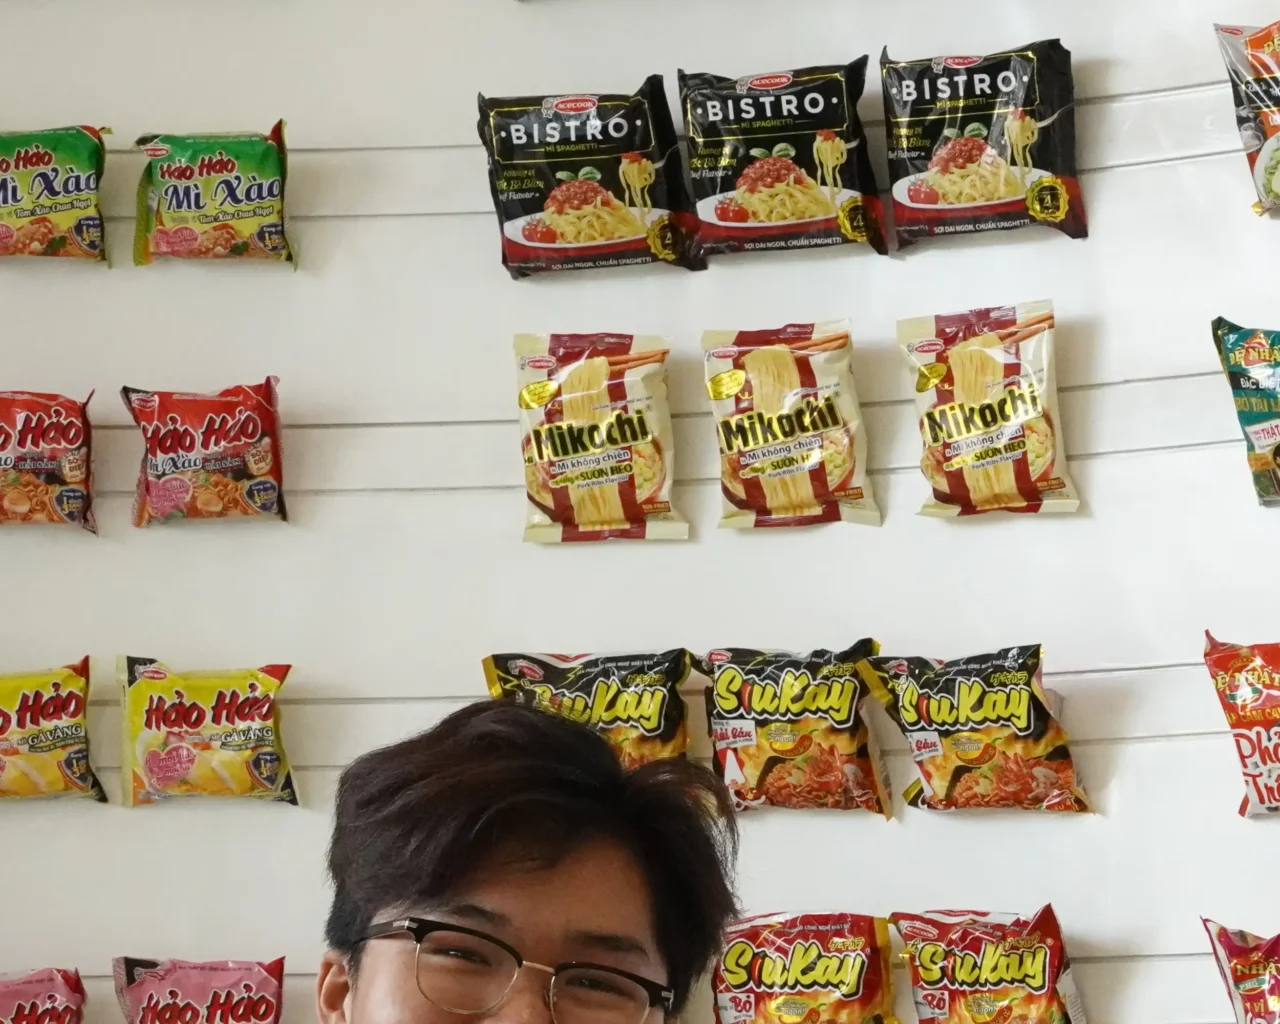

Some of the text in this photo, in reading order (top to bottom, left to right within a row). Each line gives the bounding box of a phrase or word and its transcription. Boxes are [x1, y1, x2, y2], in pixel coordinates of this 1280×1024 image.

[902, 71, 1016, 102] BISTRO
[706, 92, 824, 122] BISTRO
[510, 117, 628, 144] BISTRO
[752, 119, 794, 128] SPAGHETTI
[556, 143, 598, 151] SPAGHETTI
[163, 182, 206, 213] Mì
[720, 395, 841, 453] Mikochi
[925, 384, 1040, 444] Mikochi
[532, 409, 650, 460] Mikochi
[1004, 440, 1026, 454] HEO
[610, 463, 633, 476] HEO
[145, 689, 206, 731] Hảo
